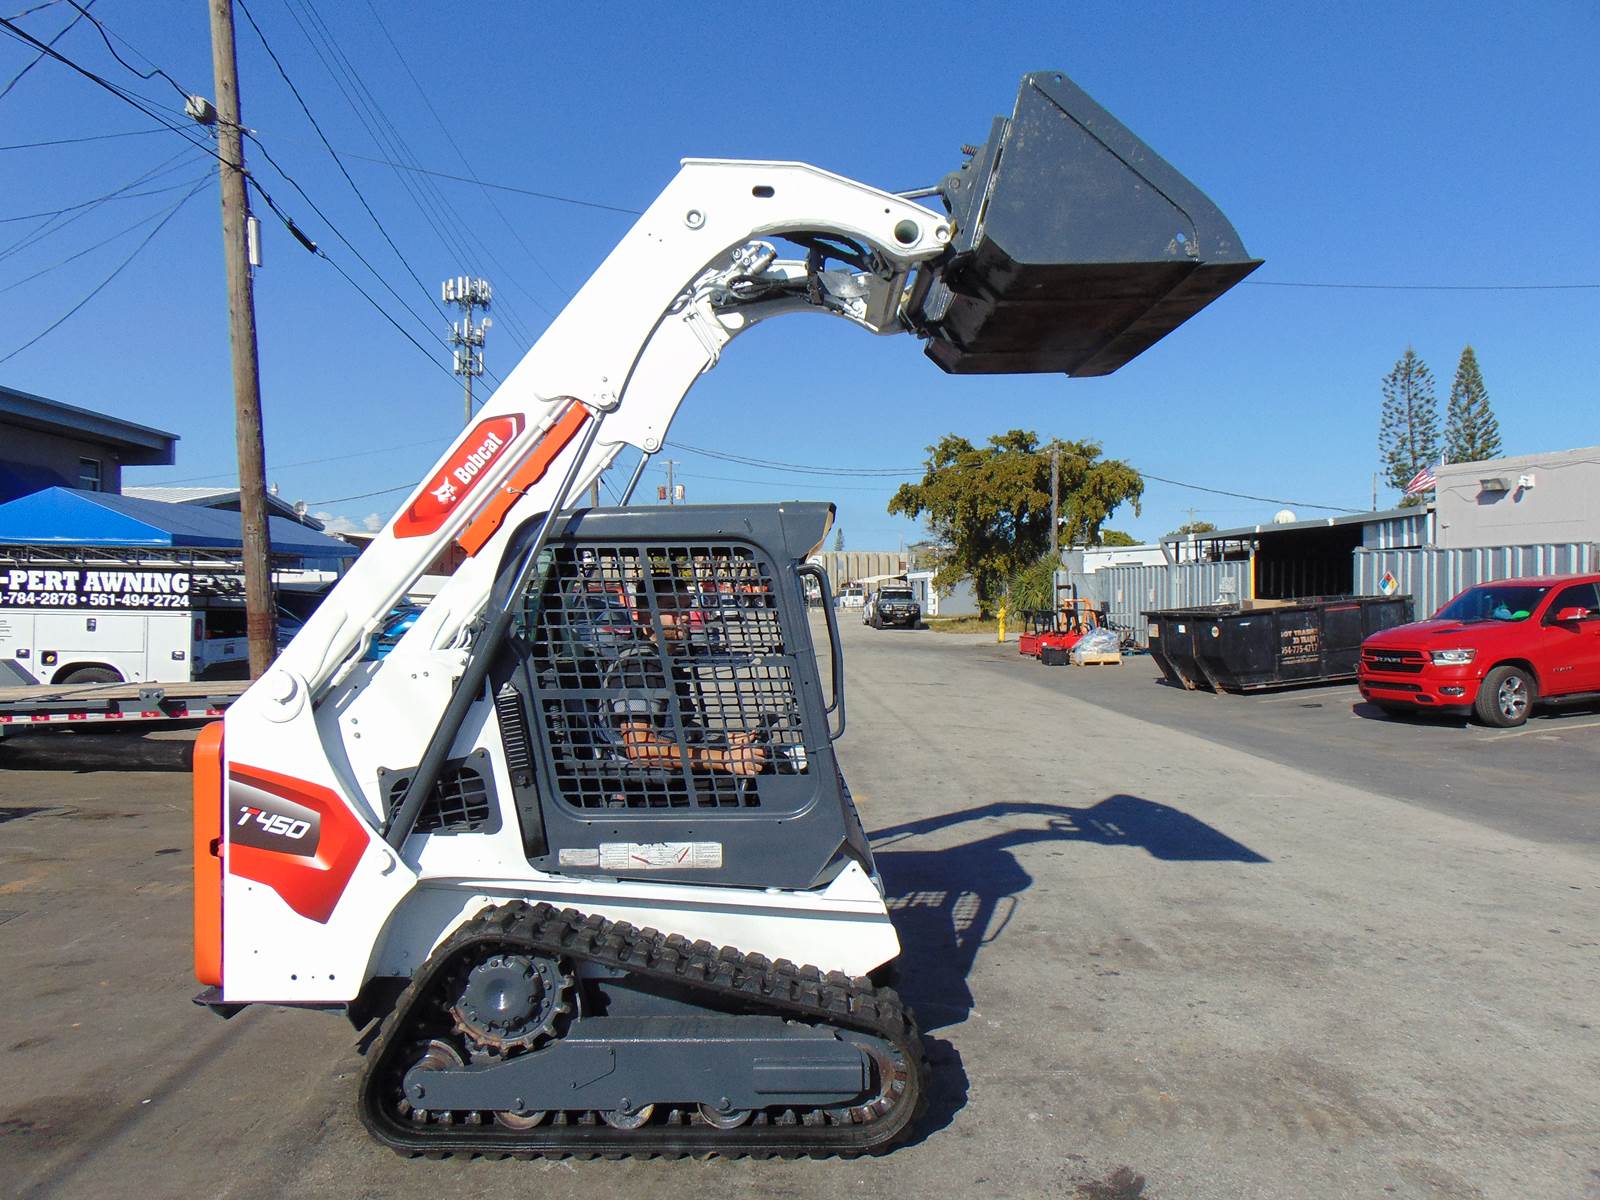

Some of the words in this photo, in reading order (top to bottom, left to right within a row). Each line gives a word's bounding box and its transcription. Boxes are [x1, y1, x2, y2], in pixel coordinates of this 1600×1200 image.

[453, 432, 503, 485] Bobcat
[83, 571, 190, 594] AWNING
[0, 592, 77, 606] -784-2878
[89, 593, 190, 607] 561-494-2724
[237, 806, 312, 840] T450
